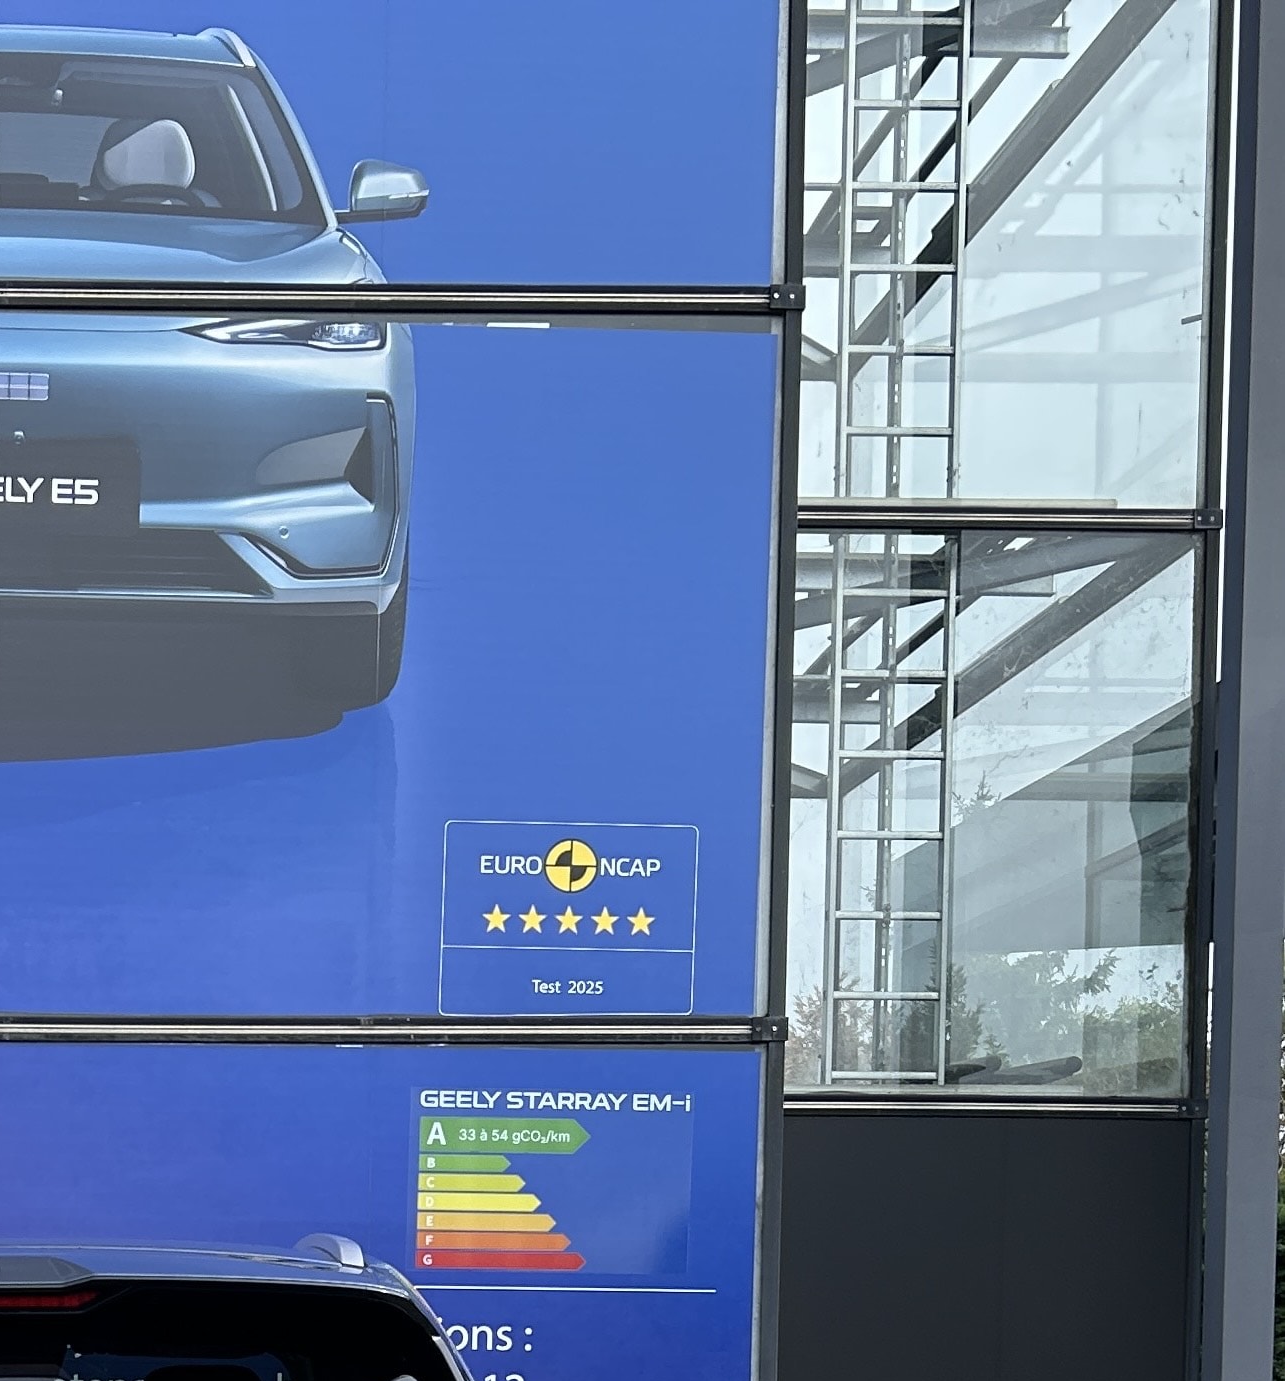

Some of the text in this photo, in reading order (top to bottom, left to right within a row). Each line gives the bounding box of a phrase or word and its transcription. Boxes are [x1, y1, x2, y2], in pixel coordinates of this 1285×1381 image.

[51, 478, 99, 505] E5
[479, 855, 661, 877] EURO NCAP
[531, 979, 604, 995] Test 2025
[420, 1090, 692, 1112] GEELY STARRAY EM-i
[426, 1121, 447, 1146] A
[458, 1128, 476, 1142] 33
[479, 1127, 488, 1142] à
[491, 1130, 509, 1142] 54
[427, 1157, 436, 1168] B
[426, 1176, 435, 1188] C
[425, 1196, 434, 1207] D
[426, 1215, 434, 1226] E
[425, 1234, 434, 1246] F
[422, 1253, 433, 1265] G
[437, 1316, 513, 1351] ons
